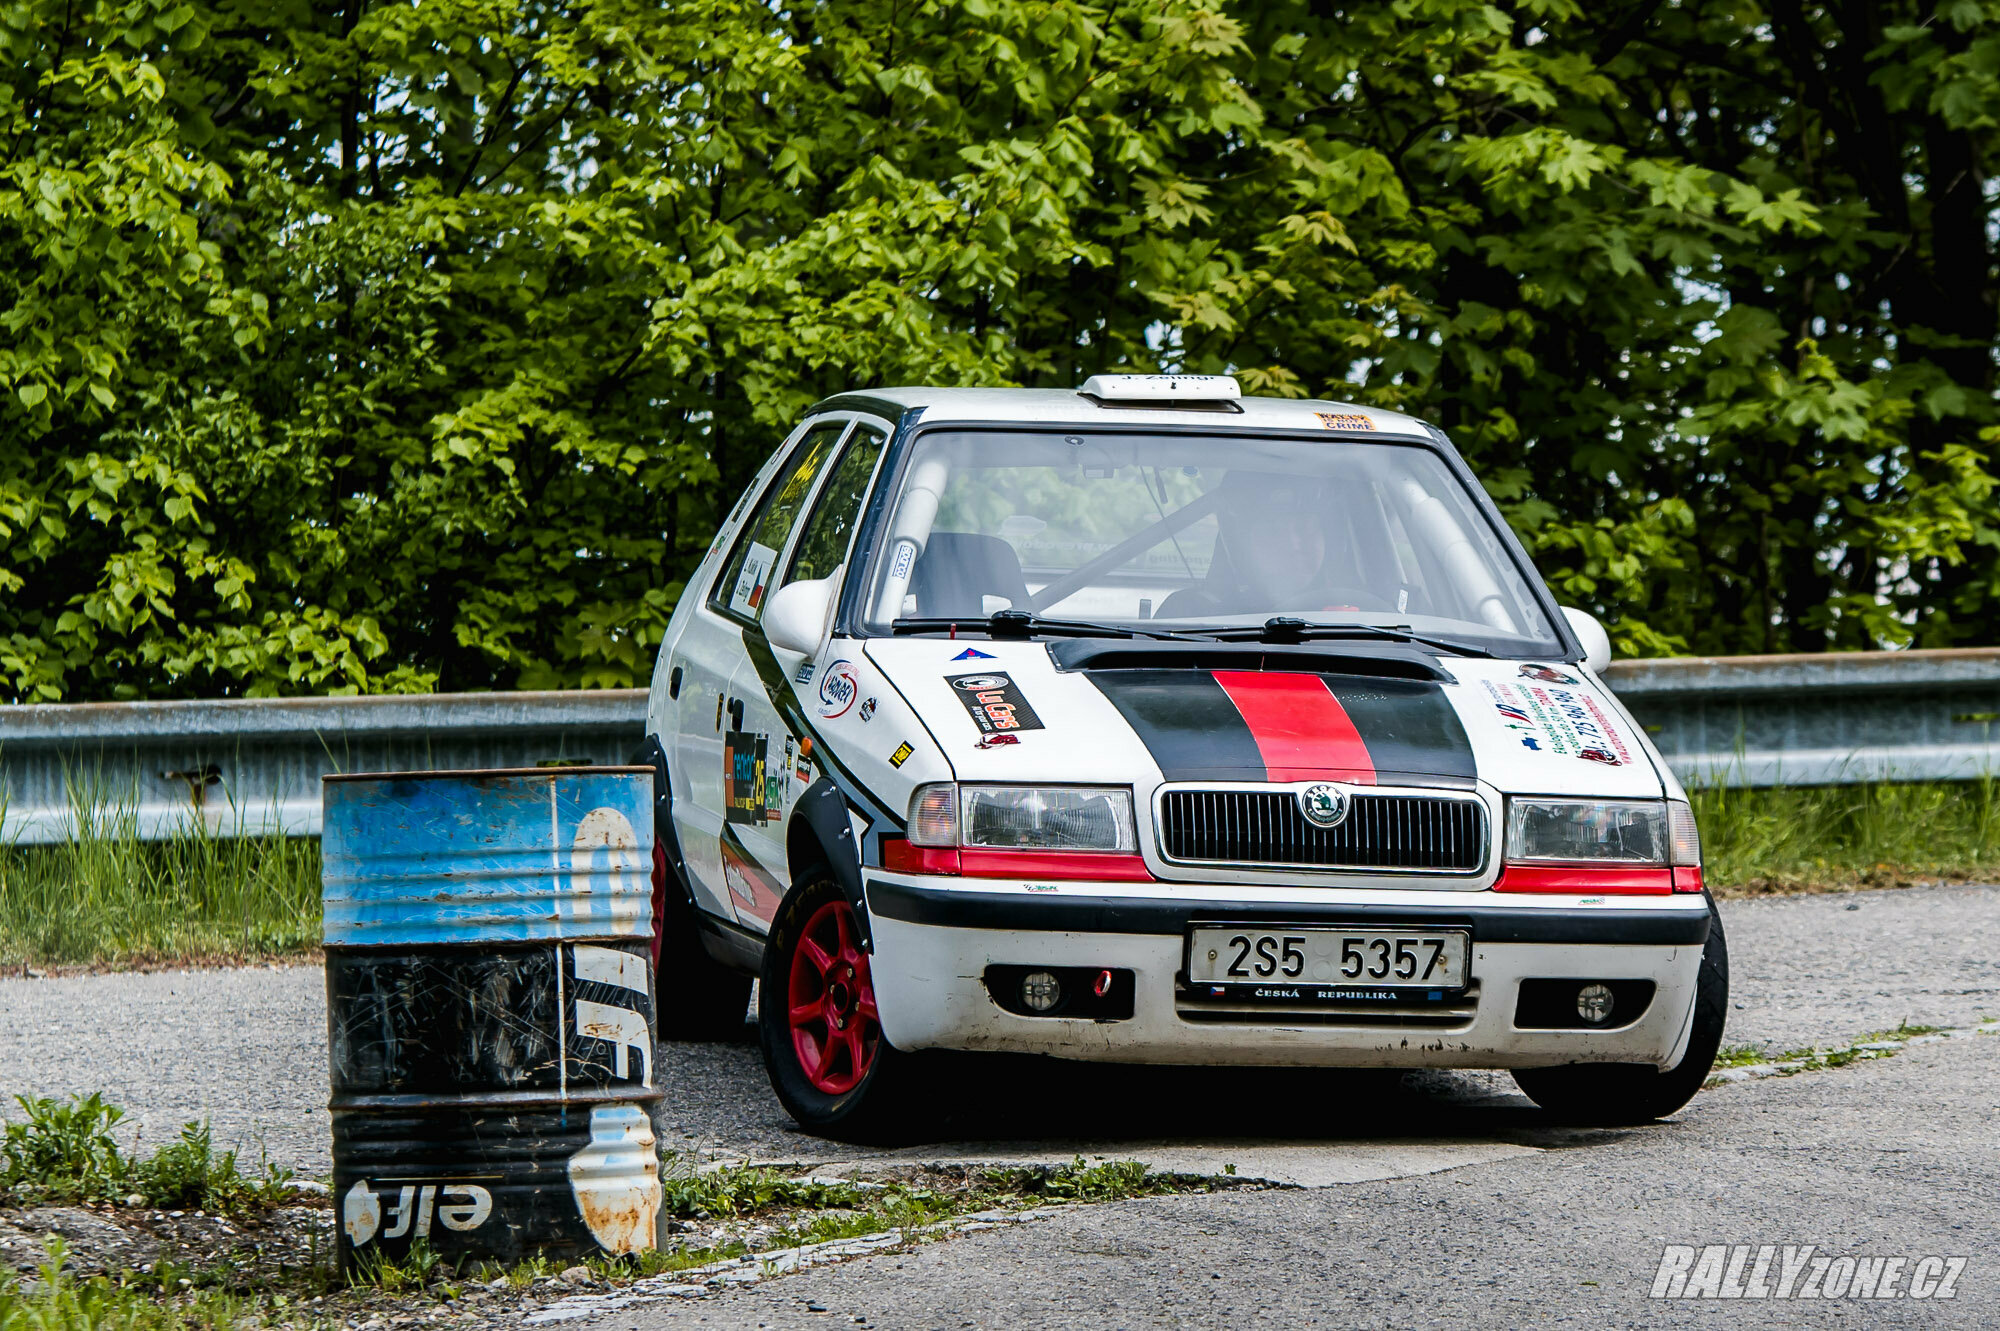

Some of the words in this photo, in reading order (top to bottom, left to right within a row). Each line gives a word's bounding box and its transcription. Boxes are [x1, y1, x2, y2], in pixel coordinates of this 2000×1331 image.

[1326, 422, 1375, 430] CRIME
[1227, 935, 1306, 979] 2S5
[1340, 938, 1445, 981] 5357
[1254, 988, 1300, 998] ČESKÁ
[1317, 991, 1398, 1000] REPUBLIKA
[384, 1184, 494, 1239] elf
